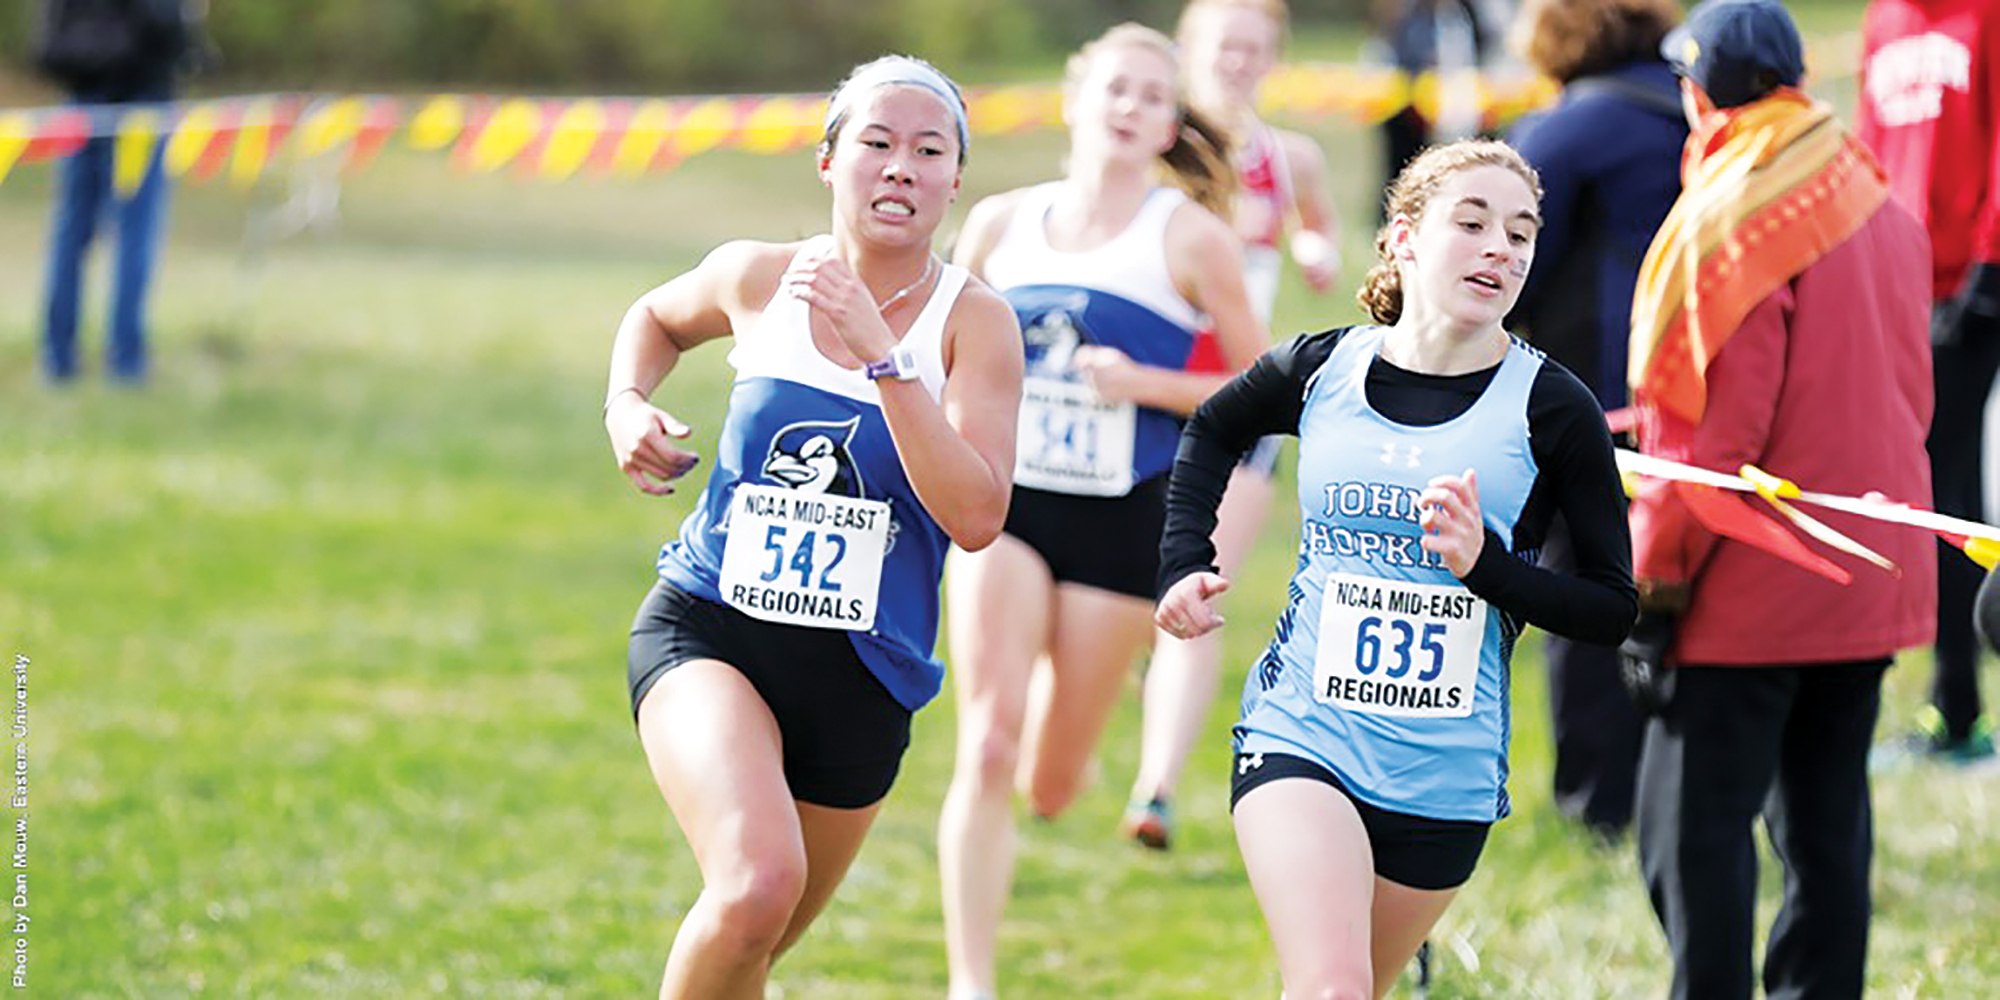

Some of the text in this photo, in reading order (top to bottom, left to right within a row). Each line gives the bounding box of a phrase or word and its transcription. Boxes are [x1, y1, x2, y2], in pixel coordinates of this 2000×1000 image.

[745, 494, 787, 520] NCAA
[793, 500, 878, 531] MID-EAST
[760, 524, 847, 592] 542
[1307, 518, 1451, 571] HOPKI
[732, 584, 863, 622] REGIONALS
[1337, 582, 1476, 620] NCAA MID-EAST
[1355, 616, 1447, 682] 635
[1327, 675, 1462, 709] REGIONALS
